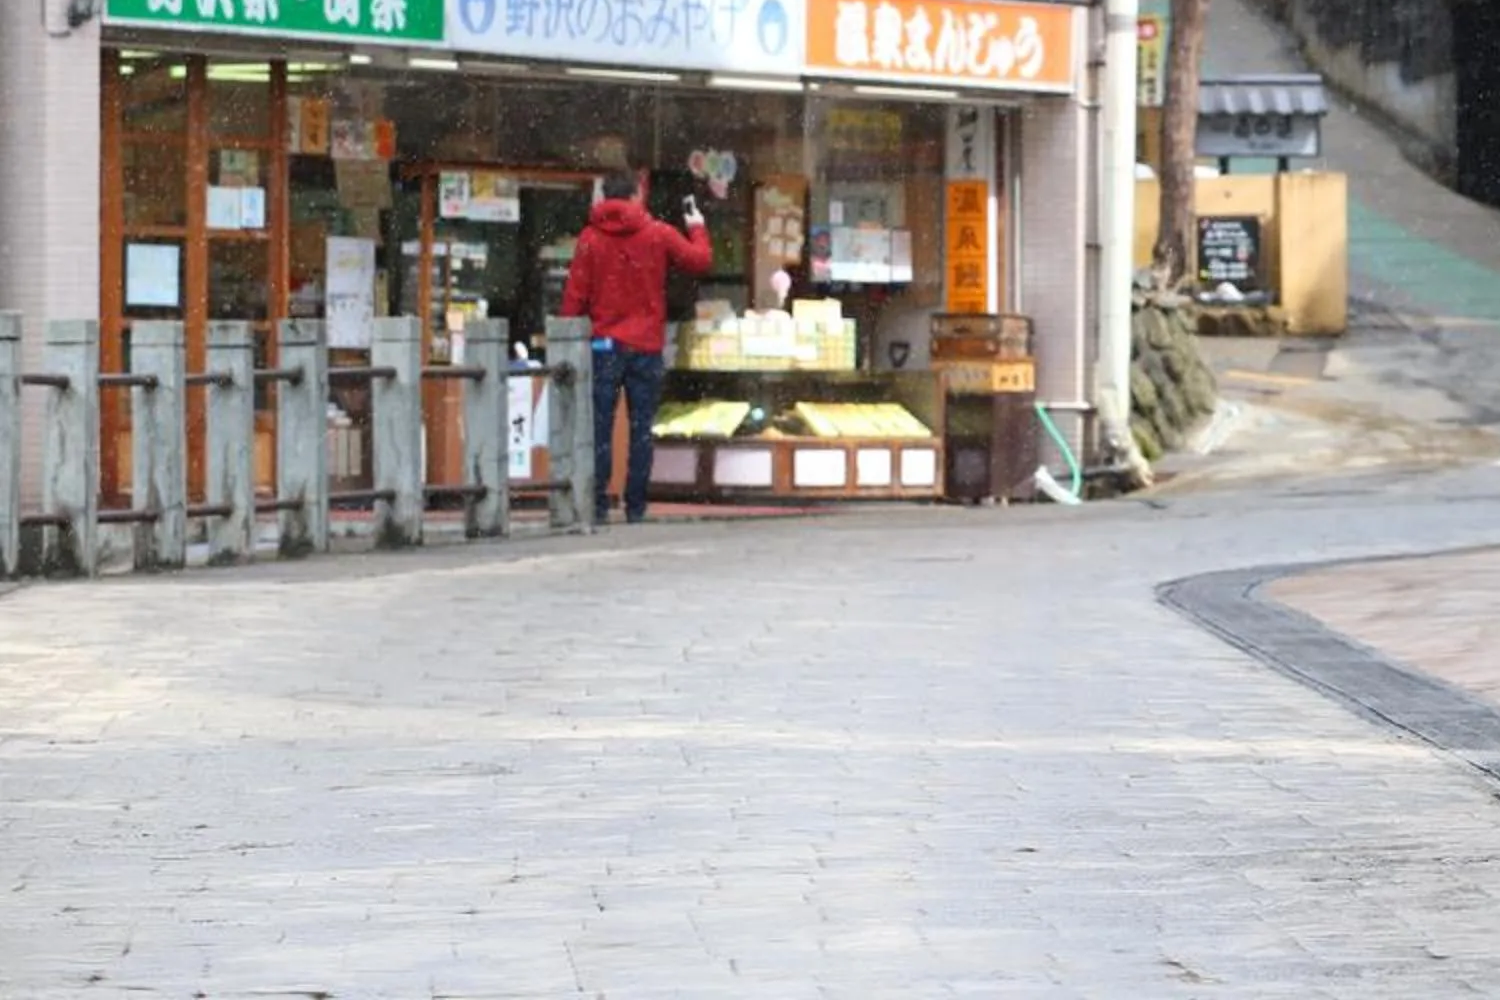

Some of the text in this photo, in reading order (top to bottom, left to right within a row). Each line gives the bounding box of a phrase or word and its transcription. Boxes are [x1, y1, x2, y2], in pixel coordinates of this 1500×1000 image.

[834, 0, 1044, 79] 温泉まんじゅう
